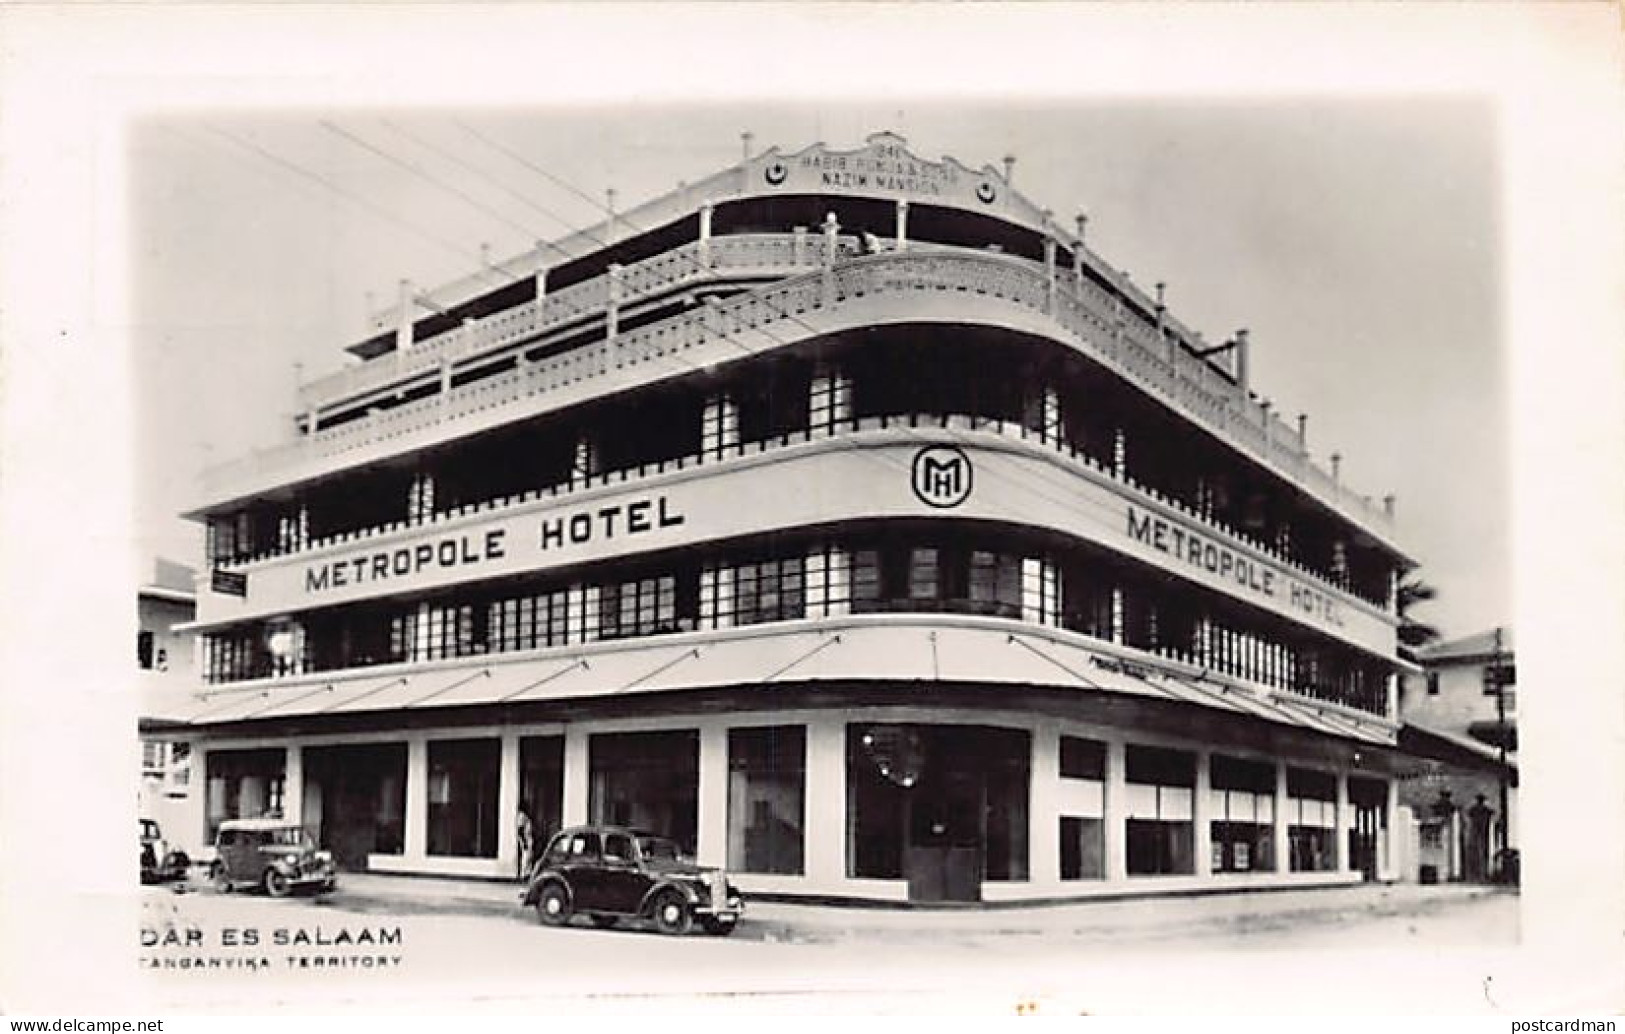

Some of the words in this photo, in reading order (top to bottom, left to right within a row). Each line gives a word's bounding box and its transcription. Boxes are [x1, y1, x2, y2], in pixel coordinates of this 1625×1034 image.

[305, 529, 506, 593] METROPOLE
[540, 495, 686, 550] HOTEL
[1127, 506, 1275, 597] METROPOLE
[1289, 581, 1345, 628] HOTEL
